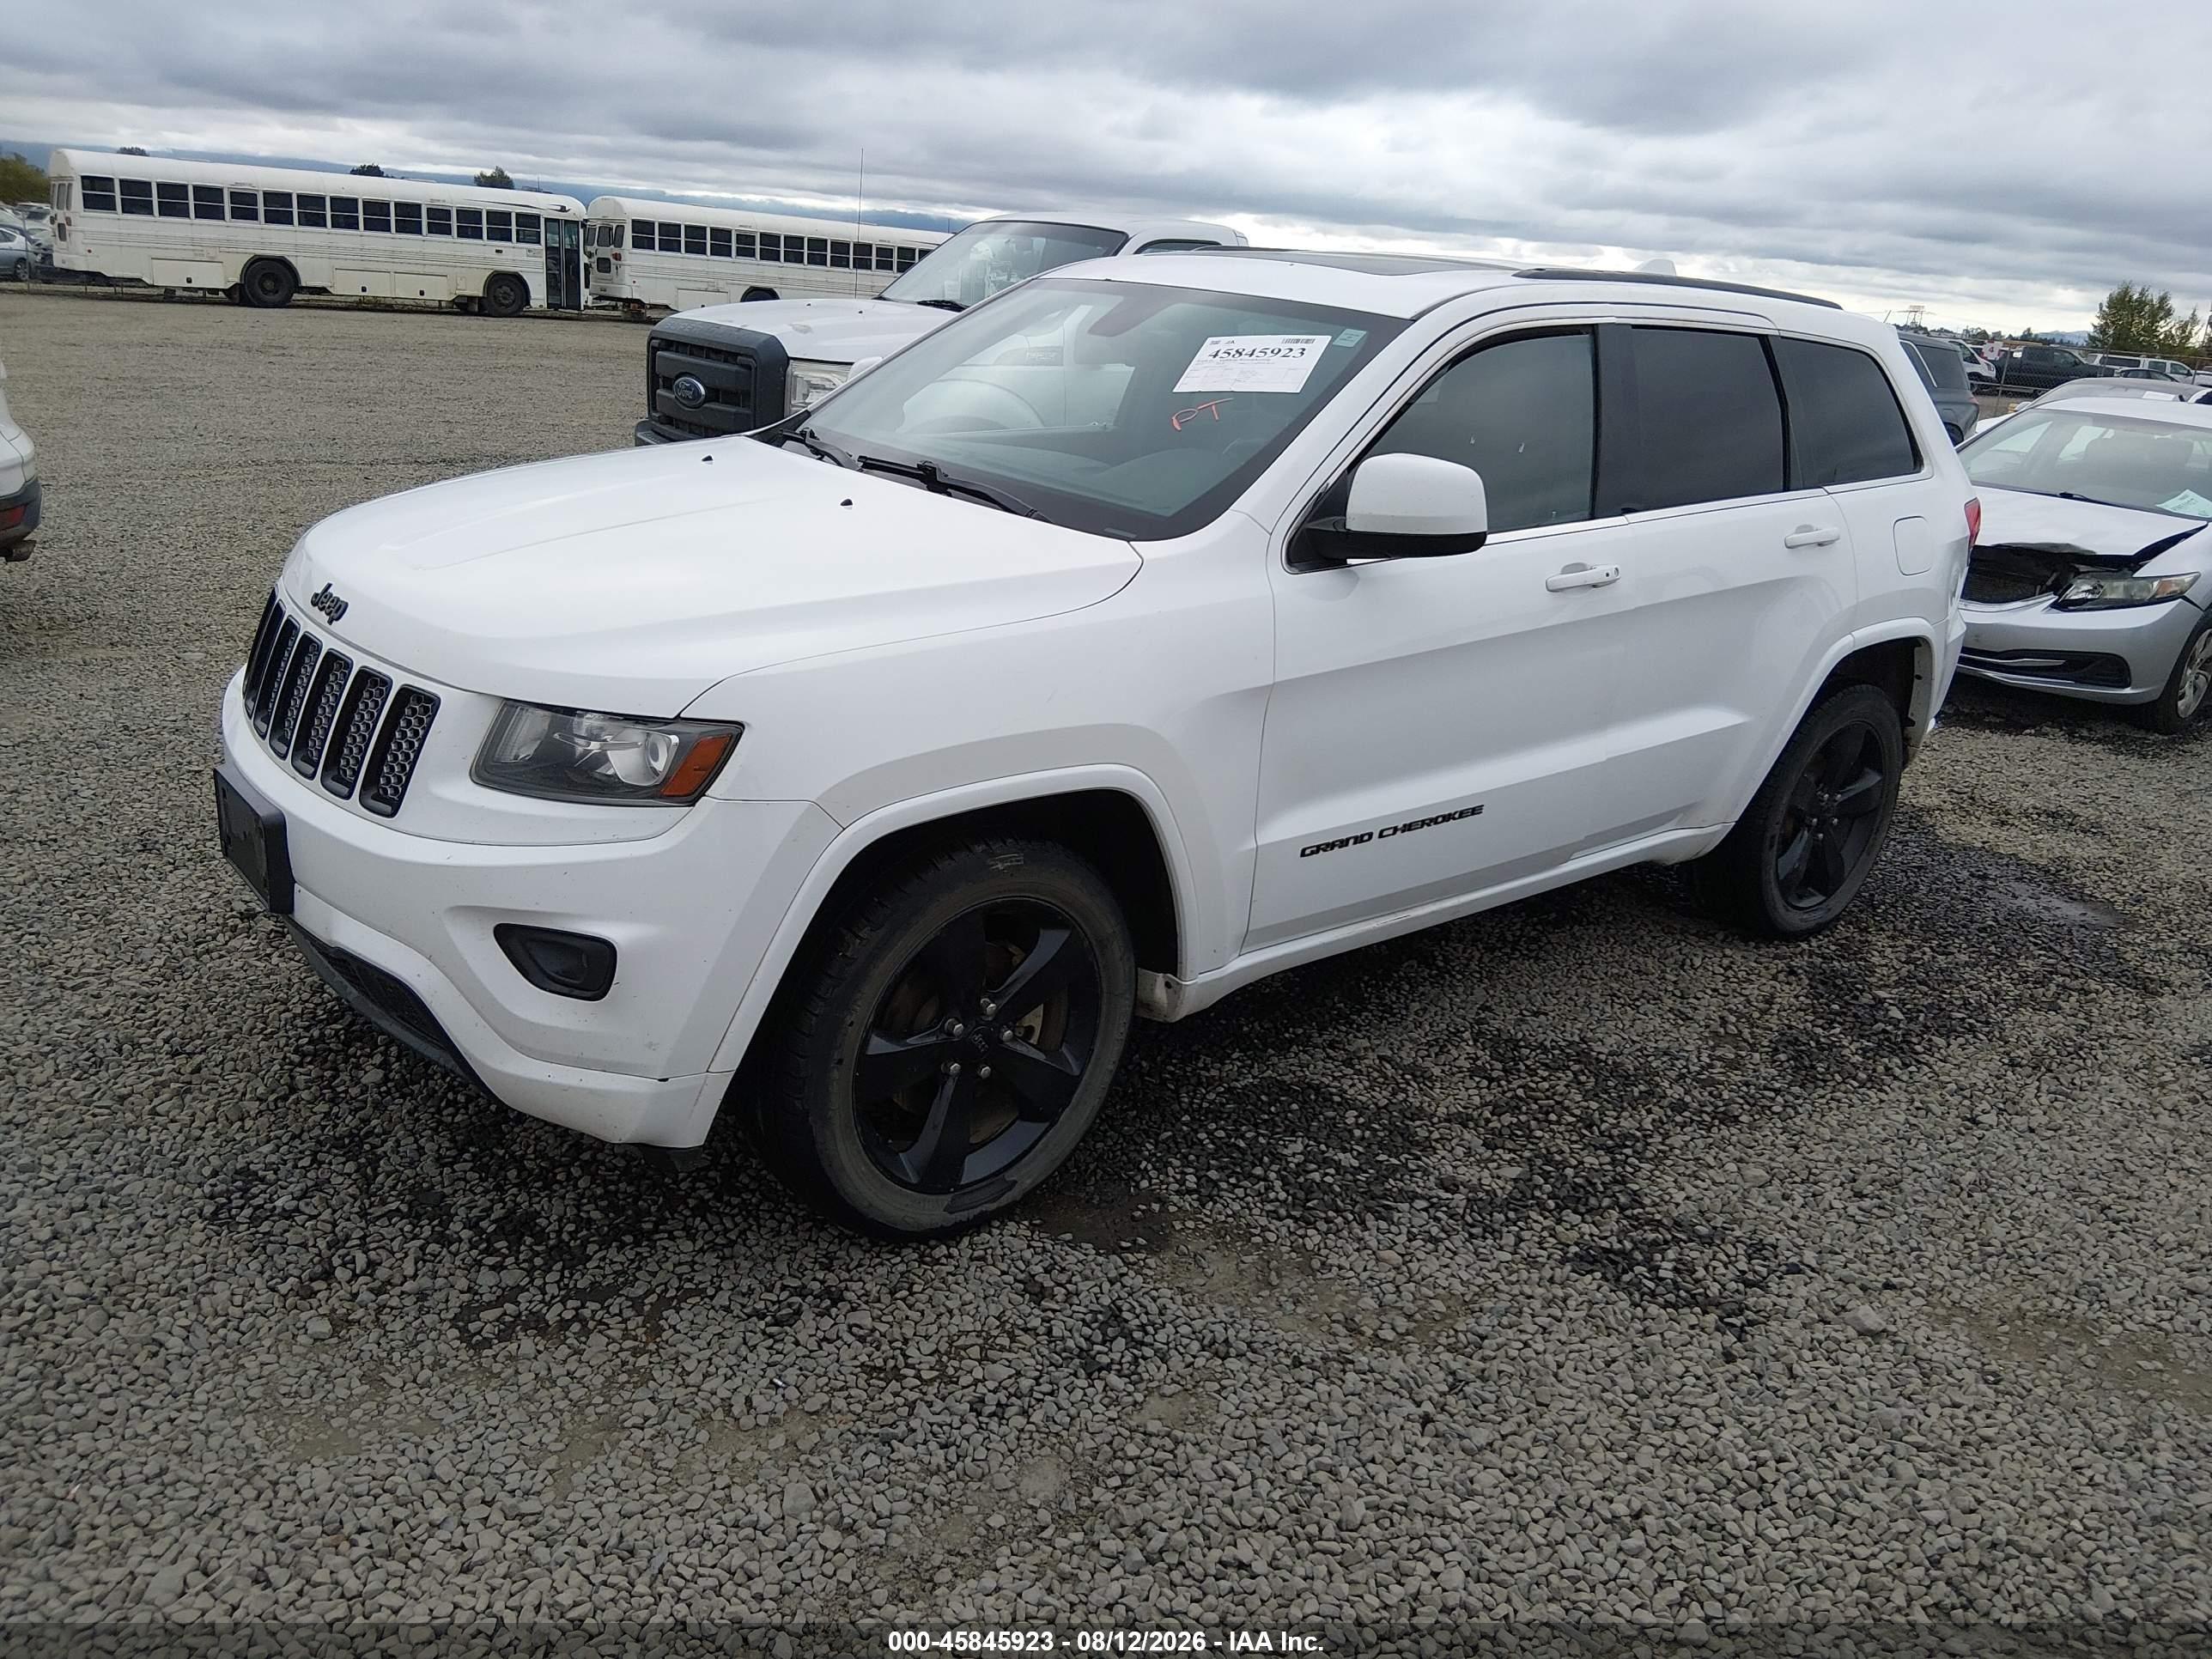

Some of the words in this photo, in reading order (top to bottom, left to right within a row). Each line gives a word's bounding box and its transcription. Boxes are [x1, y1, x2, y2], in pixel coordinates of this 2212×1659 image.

[1208, 347, 1307, 360] 45845923
[310, 582, 349, 626] Jeep
[1300, 831, 1373, 858] GRAND
[1377, 804, 1485, 839] CHEROKEE
